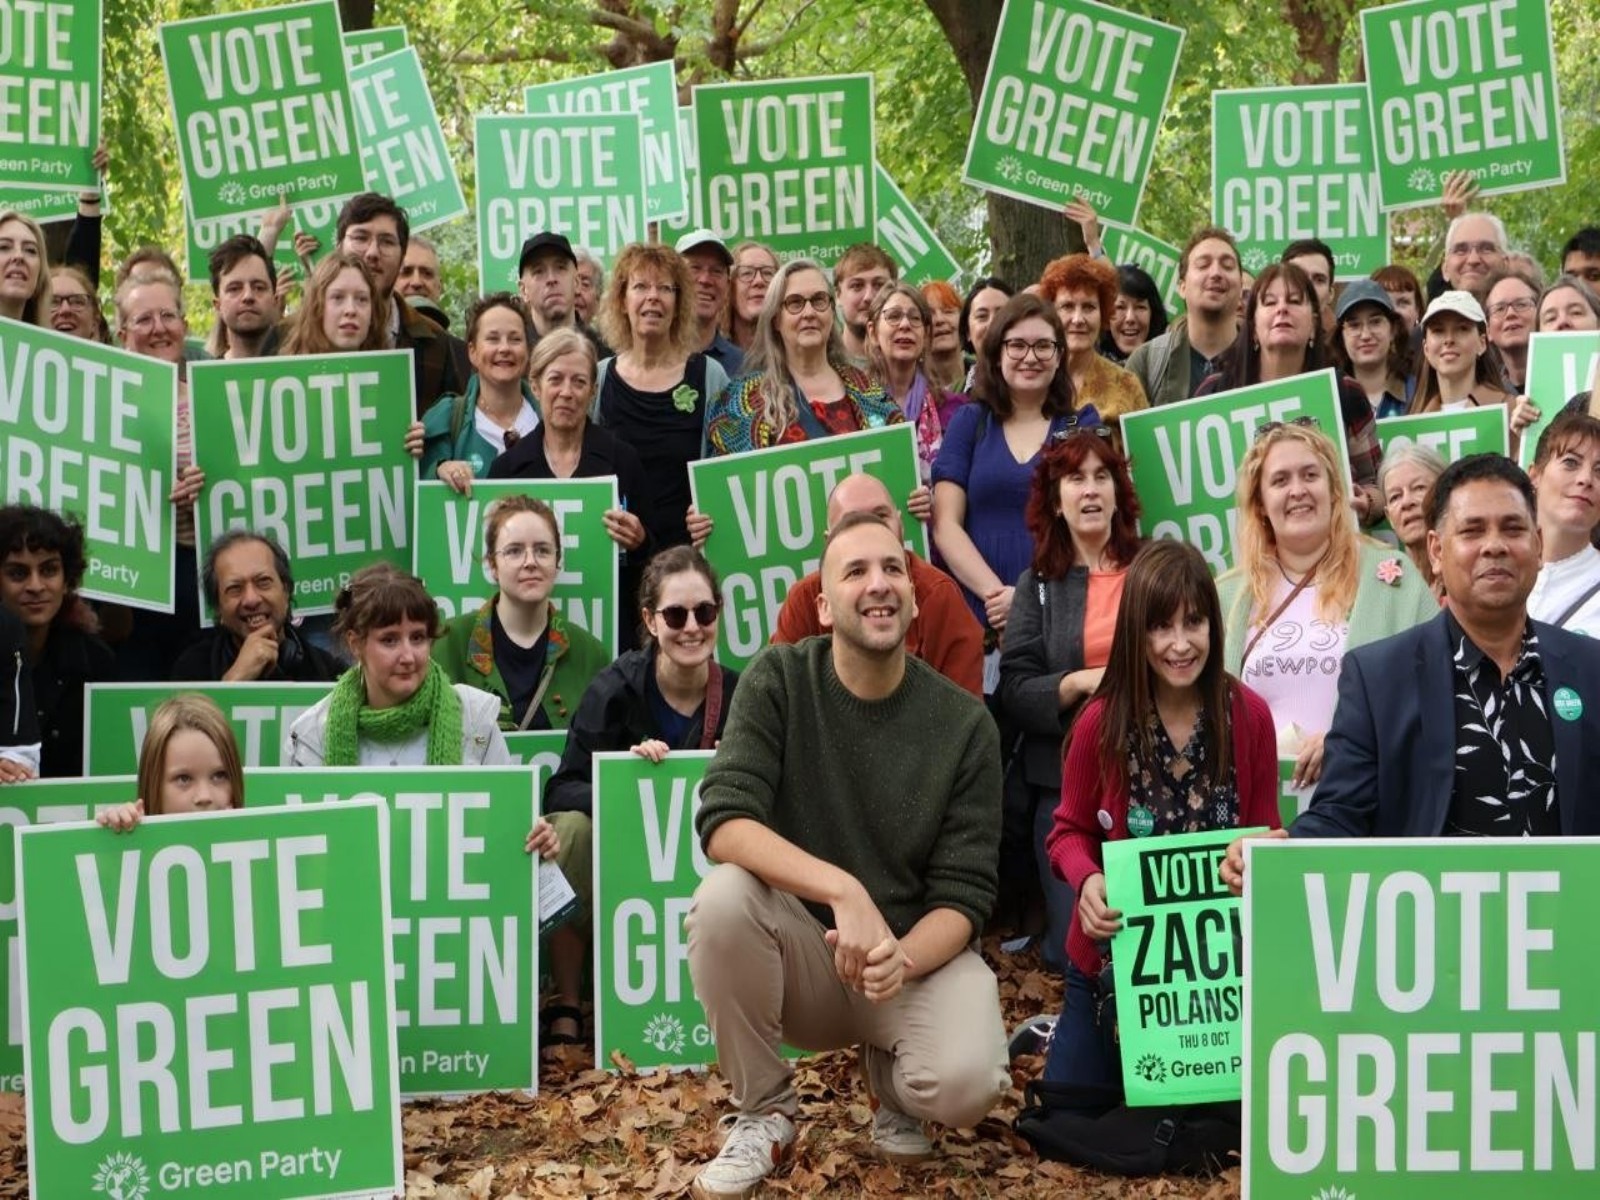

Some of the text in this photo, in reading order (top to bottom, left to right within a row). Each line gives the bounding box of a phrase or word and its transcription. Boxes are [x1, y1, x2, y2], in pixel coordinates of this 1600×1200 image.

[188, 17, 322, 100] VOTE
[1027, 0, 1154, 103] VOTE
[1389, 0, 1523, 86] VOTE
[186, 90, 351, 179] GREEN
[721, 91, 847, 165] VOTE
[986, 75, 1150, 184] GREEN
[1239, 98, 1361, 168] VOTE
[1381, 72, 1548, 165] GREEN
[31, 157, 72, 178] Party
[249, 174, 338, 199] Green Party
[500, 126, 618, 189] VOTE
[1024, 169, 1070, 195] Green
[1489, 160, 1533, 177] Party
[404, 200, 437, 219] arty
[487, 195, 638, 260] GREEN
[708, 165, 866, 240] GREEN
[1223, 172, 1379, 242] GREEN
[1333, 253, 1361, 268] arty
[0, 336, 143, 454] VOTE
[225, 371, 382, 467] VOTE
[1154, 397, 1303, 506] VOT
[209, 466, 407, 563] GREEN
[444, 500, 583, 585] VE
[89, 558, 139, 588] Party
[75, 834, 333, 985] VOTE
[1148, 850, 1231, 898] VOTE
[1304, 871, 1561, 1013] VOTE
[1139, 985, 1243, 1029] POLANS
[1178, 1034, 1199, 1049] THU
[1210, 1031, 1230, 1046] OCT
[48, 981, 374, 1144] GREEN
[423, 1050, 490, 1079] Party
[1171, 1059, 1227, 1078] Green
[1268, 1031, 1597, 1174] GREEN
[159, 1146, 342, 1191] Green Party
